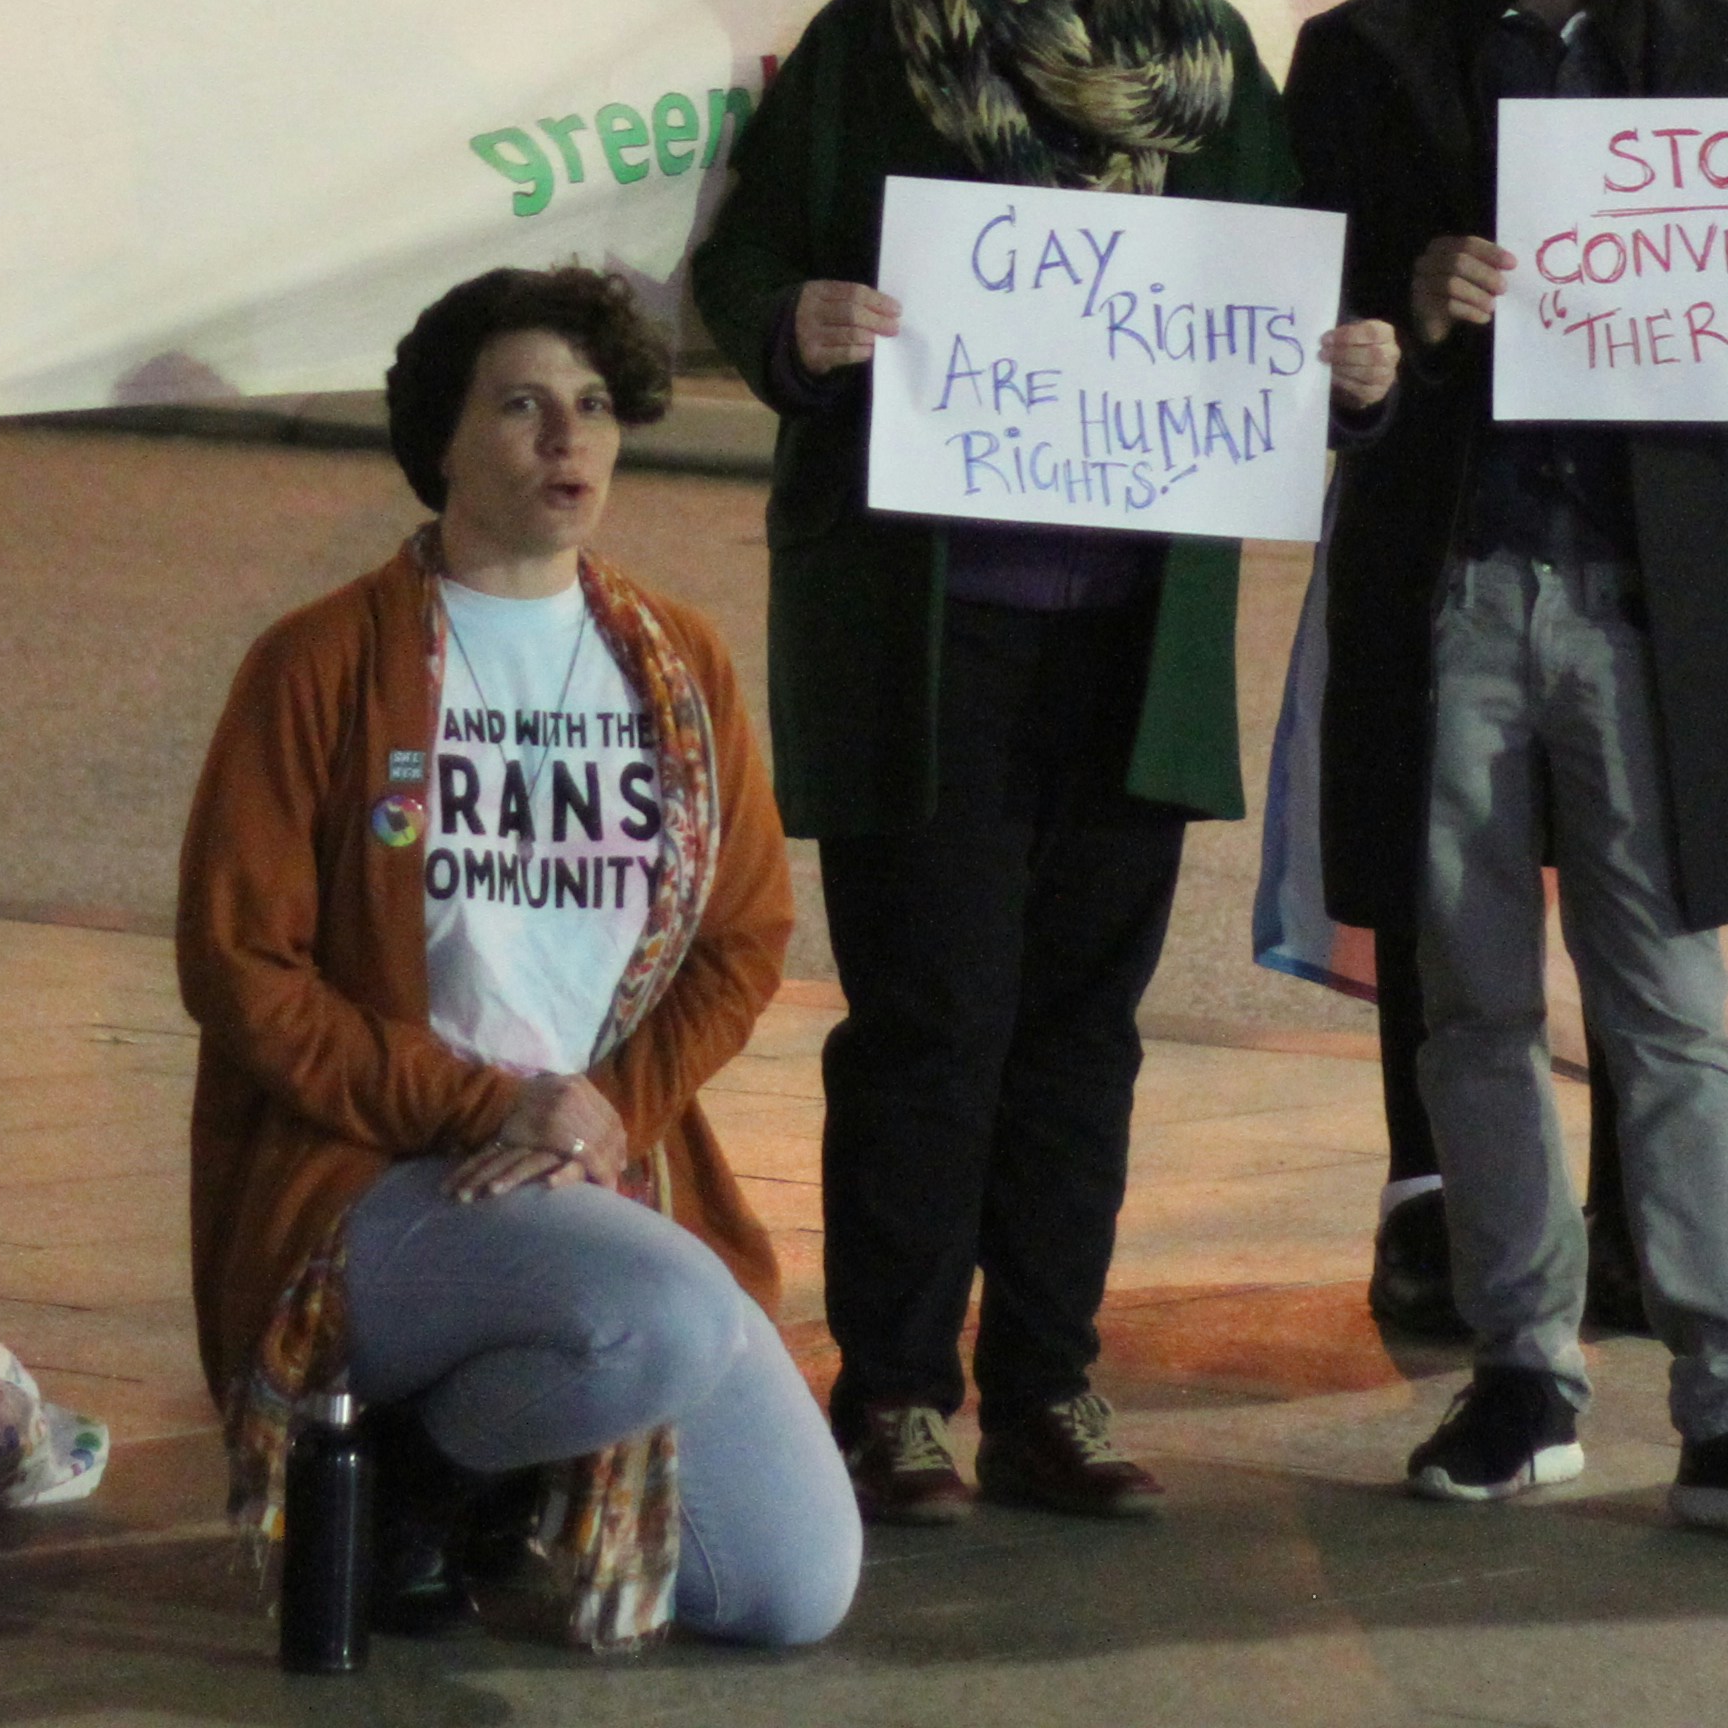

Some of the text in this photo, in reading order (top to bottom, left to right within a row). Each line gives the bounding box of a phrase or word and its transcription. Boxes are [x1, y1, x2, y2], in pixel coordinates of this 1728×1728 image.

[971, 204, 1126, 318] GAY
[931, 333, 1277, 471] ARE HUMAN
[515, 708, 587, 748] WITH
[596, 711, 656, 749] THE
